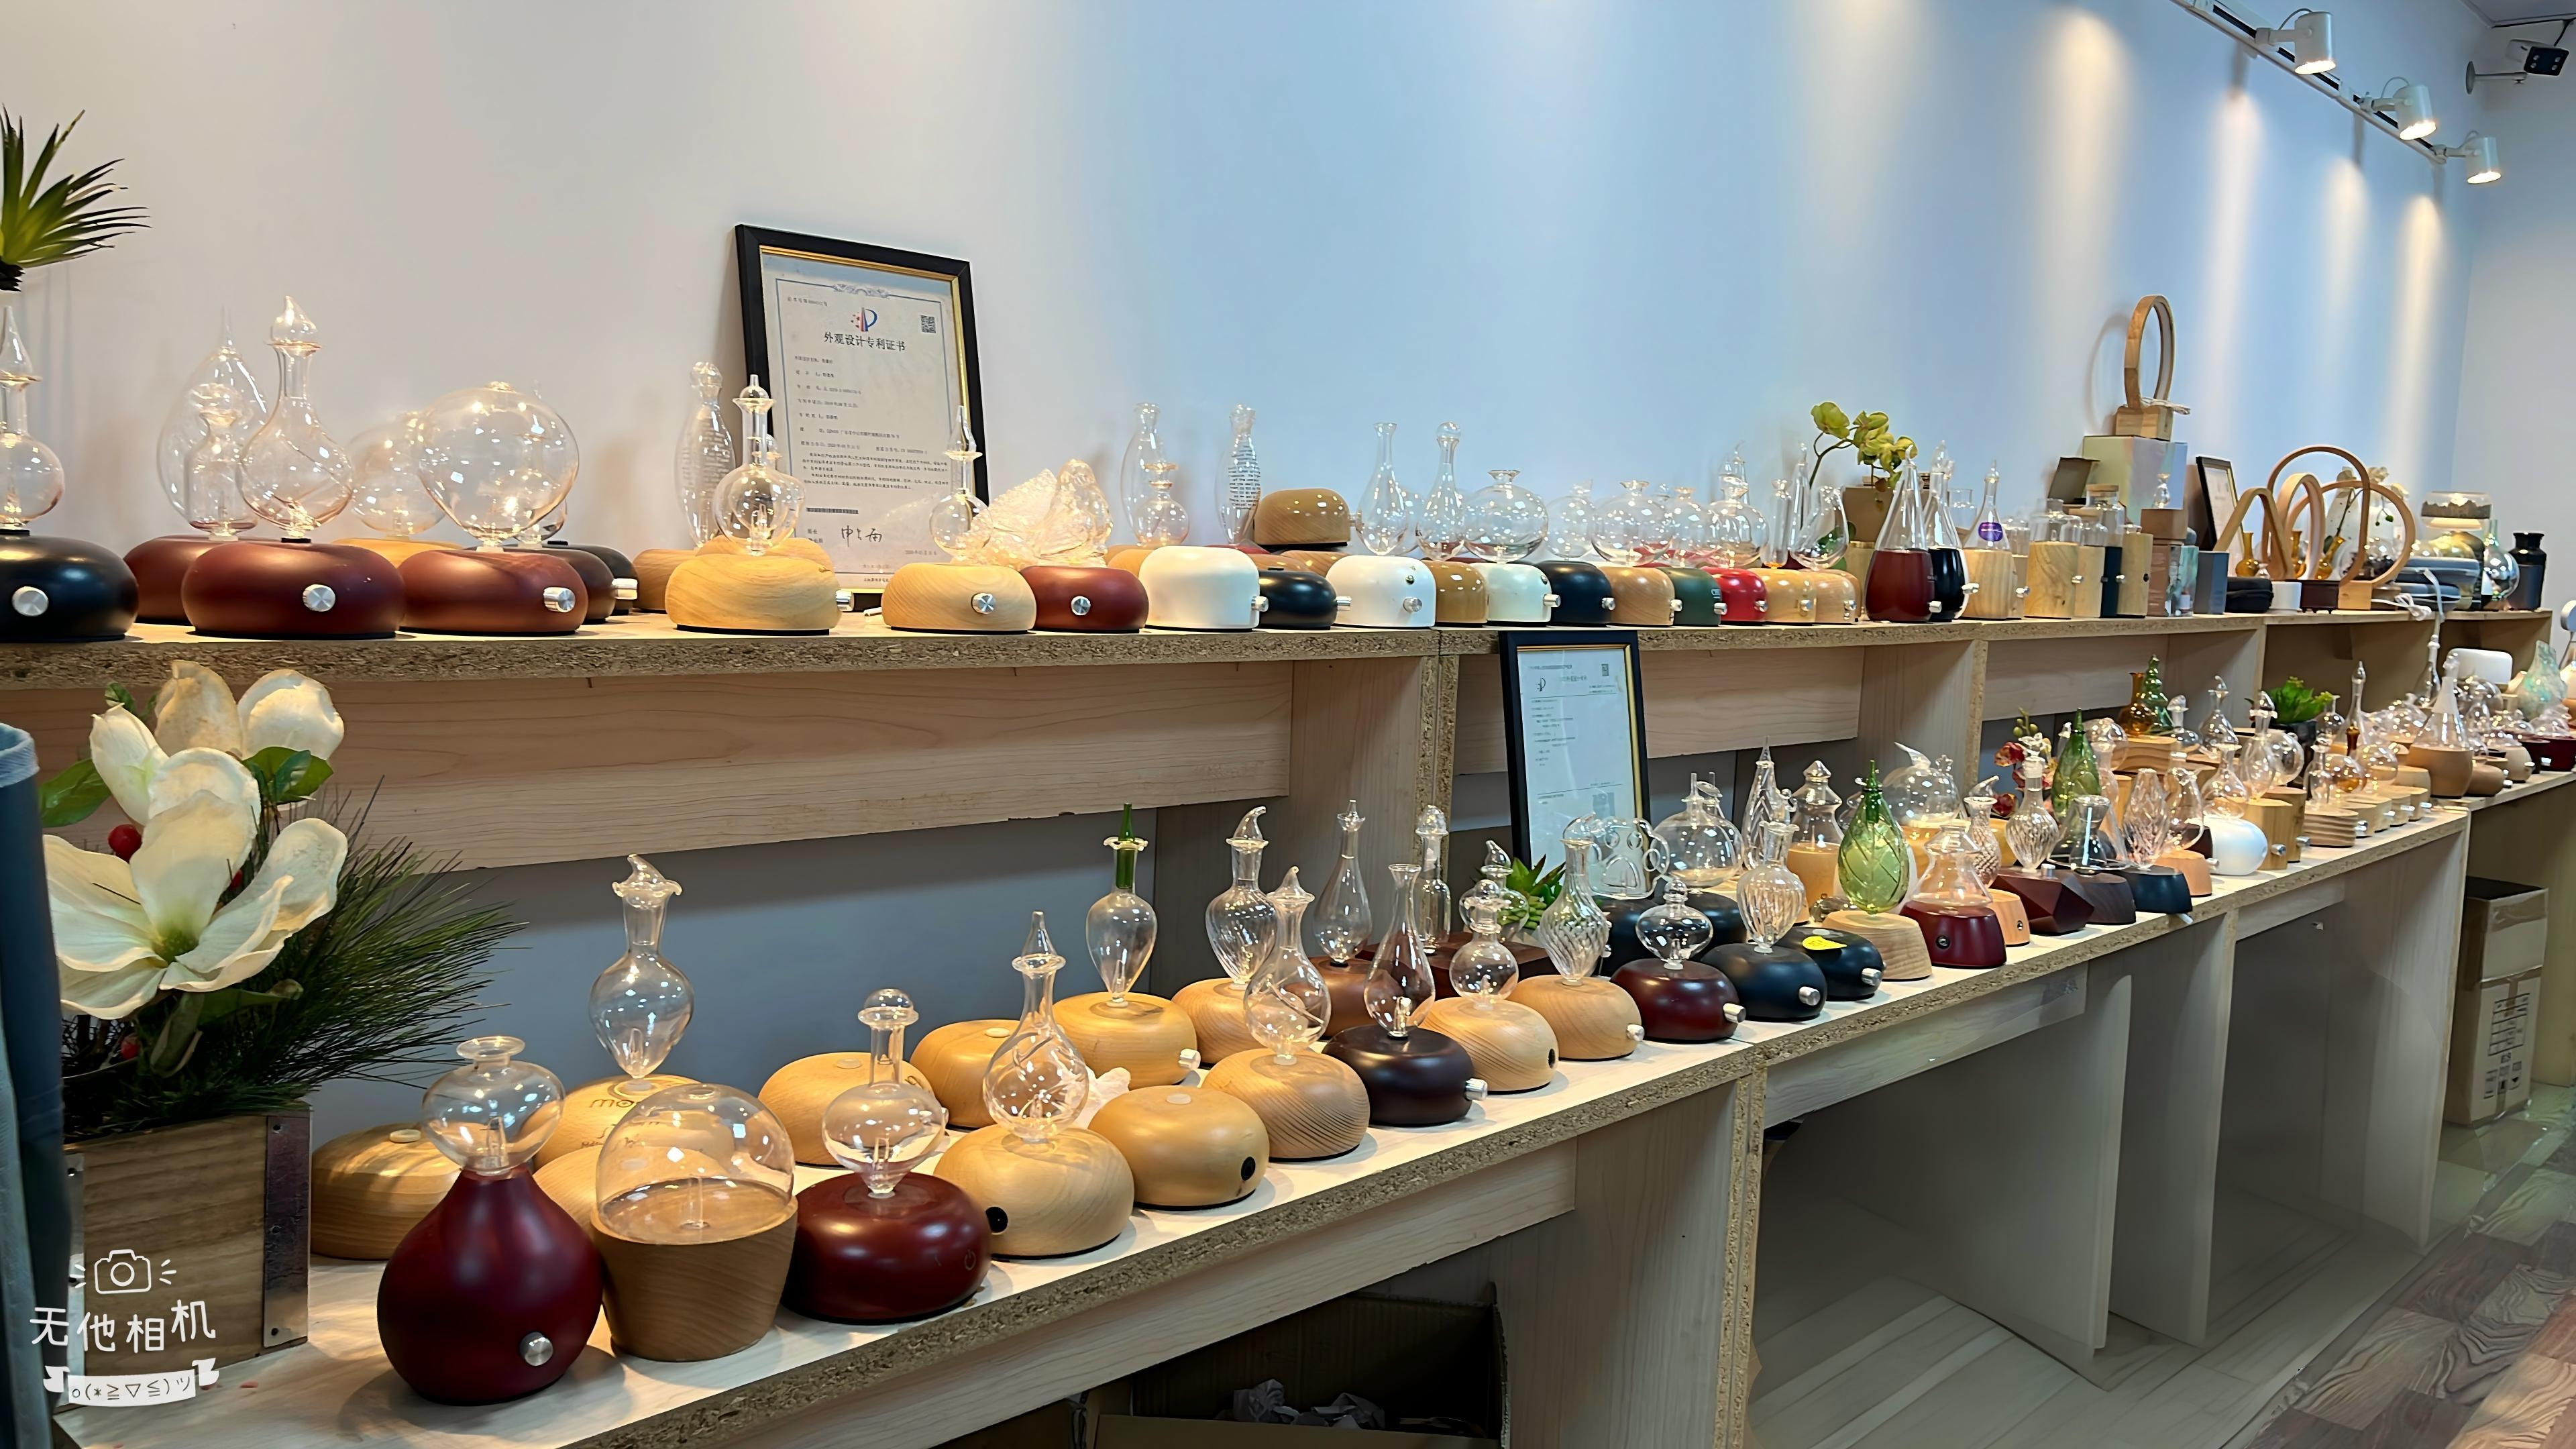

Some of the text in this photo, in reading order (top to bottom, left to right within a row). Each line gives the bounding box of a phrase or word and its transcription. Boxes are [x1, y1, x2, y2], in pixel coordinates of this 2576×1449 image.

[824, 331, 906, 351] 外观设计专利证书
